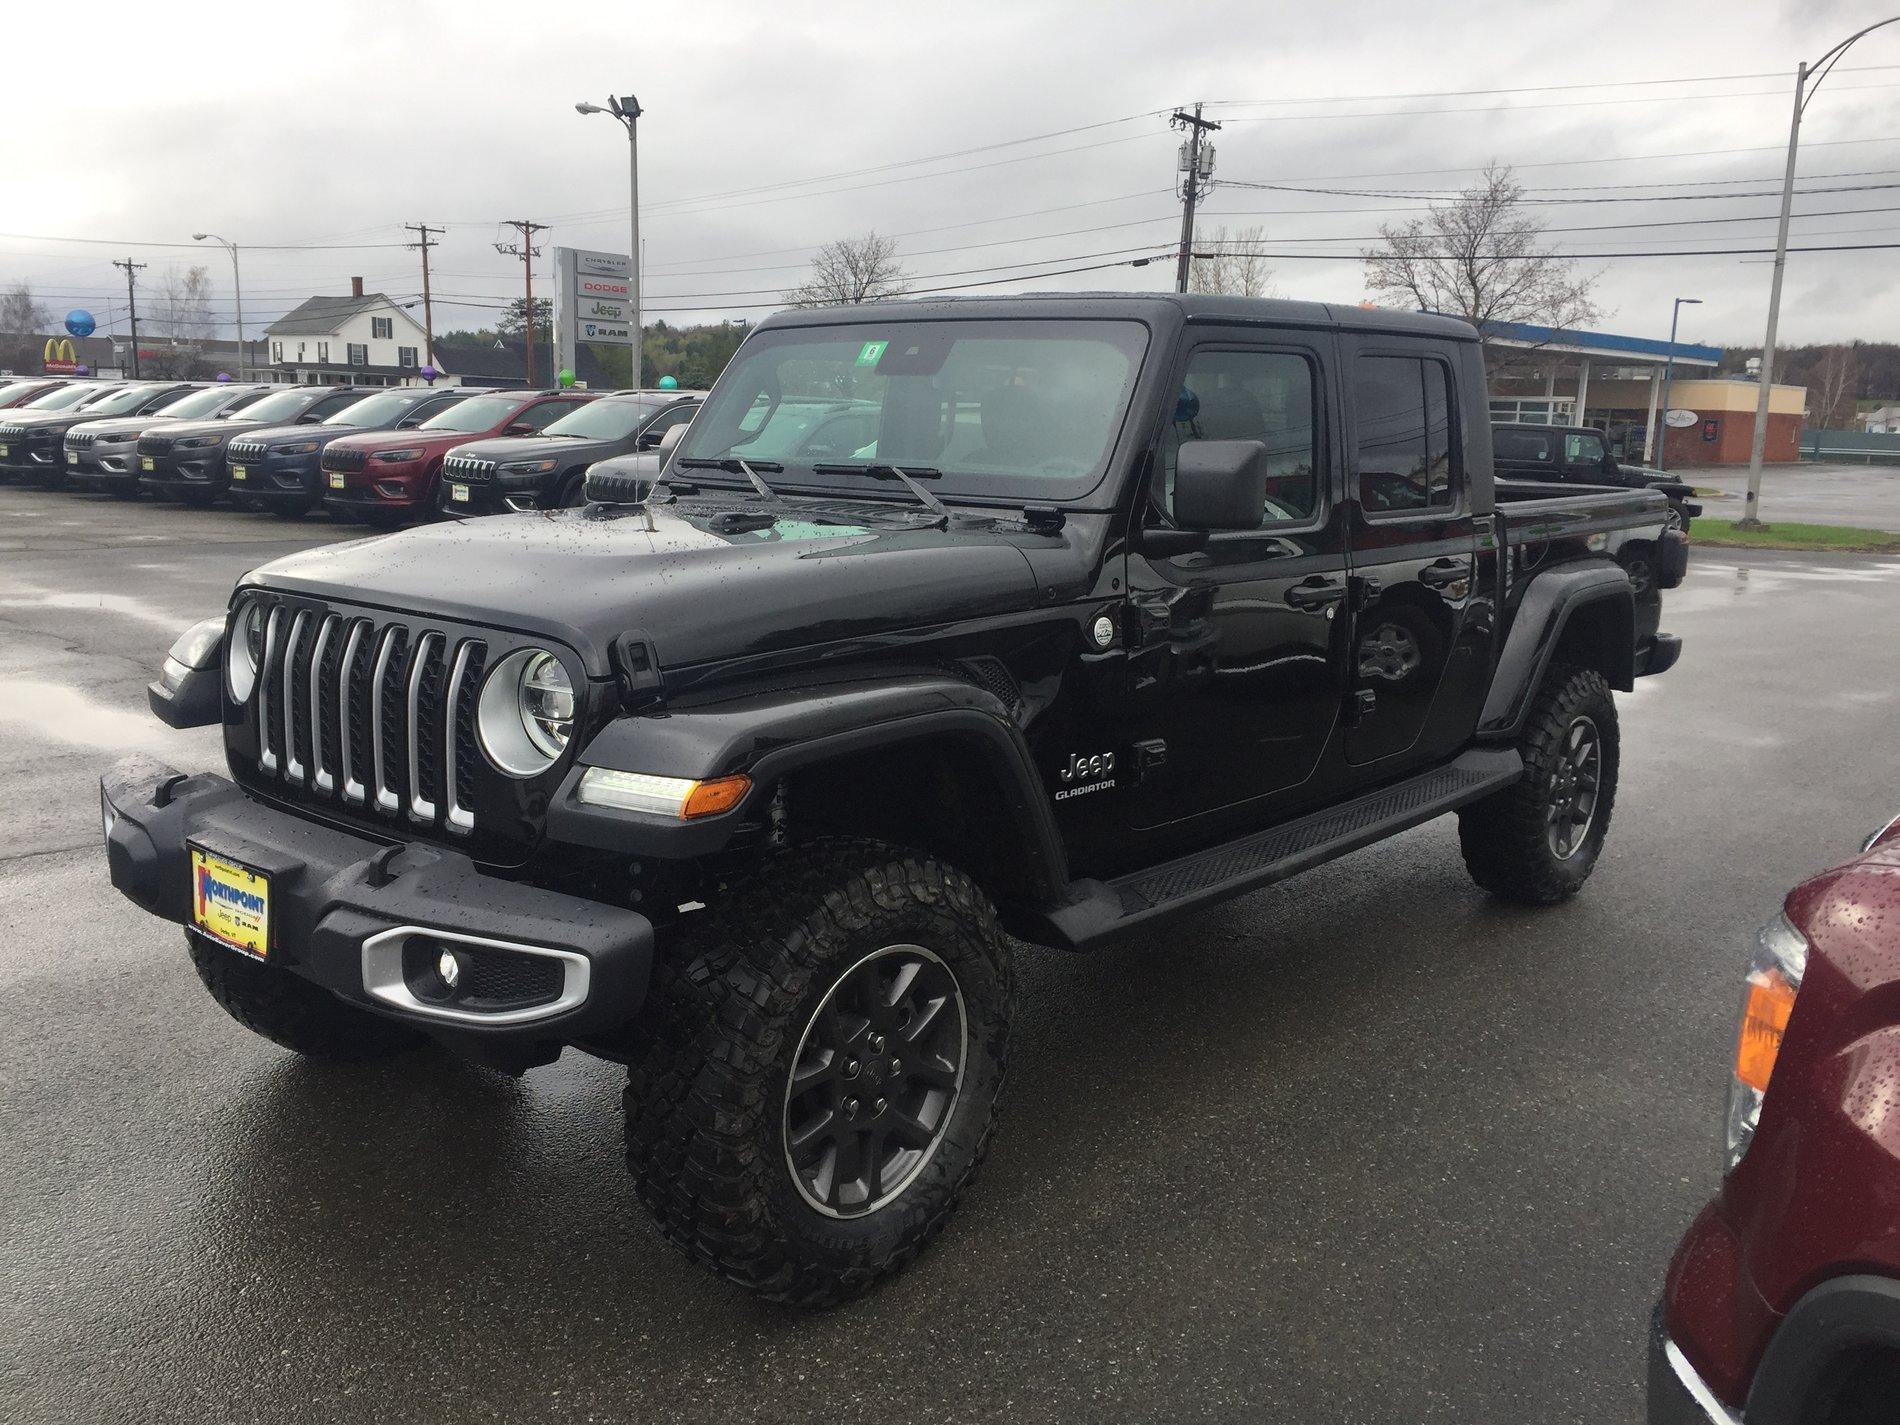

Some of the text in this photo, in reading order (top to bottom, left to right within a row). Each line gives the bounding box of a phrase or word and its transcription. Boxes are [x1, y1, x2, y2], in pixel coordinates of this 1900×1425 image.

[585, 257, 627, 266] CHRYSLER
[584, 283, 629, 293] DODGE
[591, 302, 622, 319] Jeep
[598, 329, 628, 337] RAM
[1061, 752, 1115, 781] Jeep
[1055, 780, 1115, 800] GLADIATOR
[203, 873, 265, 914] NORTHPOINT
